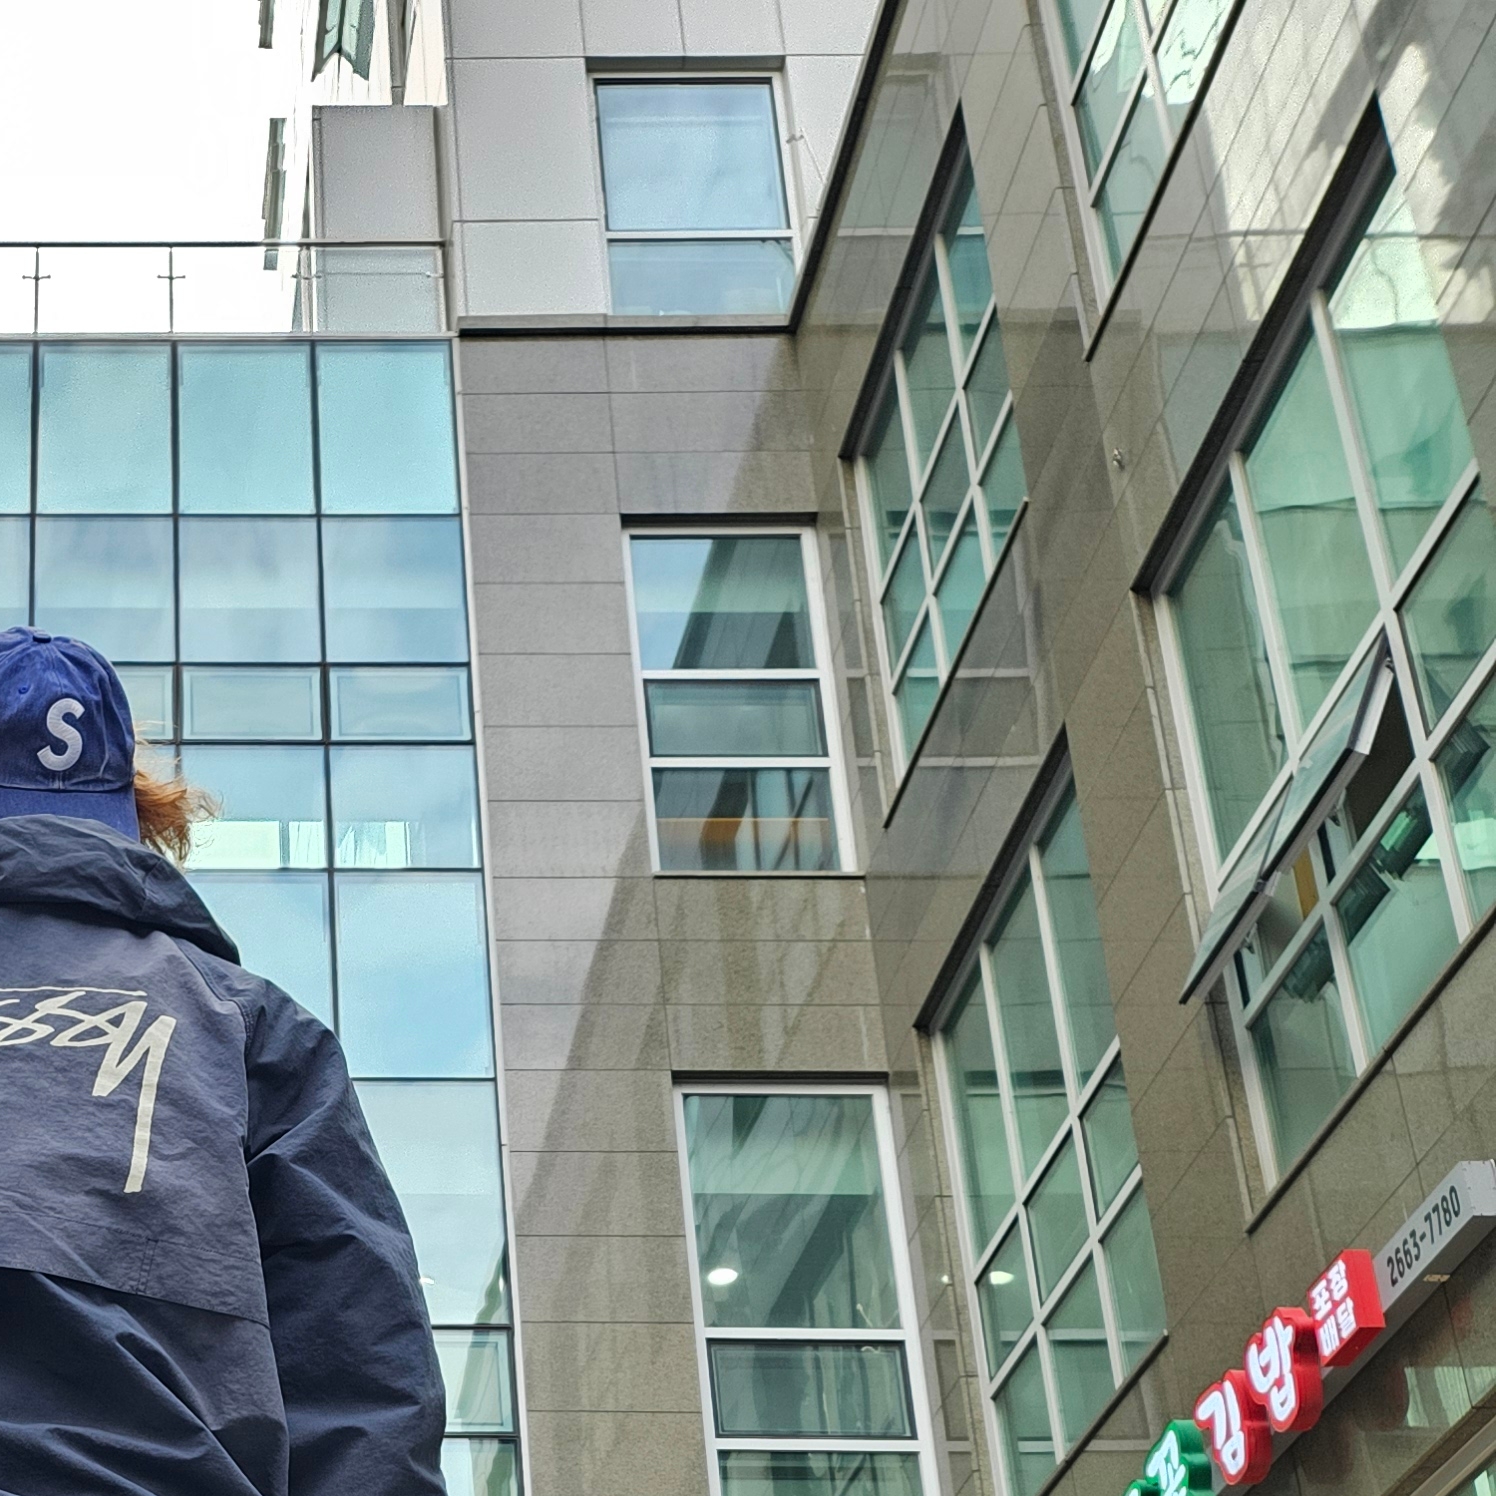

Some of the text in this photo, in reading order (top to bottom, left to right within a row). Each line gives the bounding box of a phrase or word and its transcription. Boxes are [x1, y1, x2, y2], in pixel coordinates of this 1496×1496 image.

[37, 697, 86, 772] S
[1387, 1185, 1461, 1288] 2663-7780
[1310, 1258, 1348, 1321] 포장
[1316, 1300, 1356, 1356] 배달
